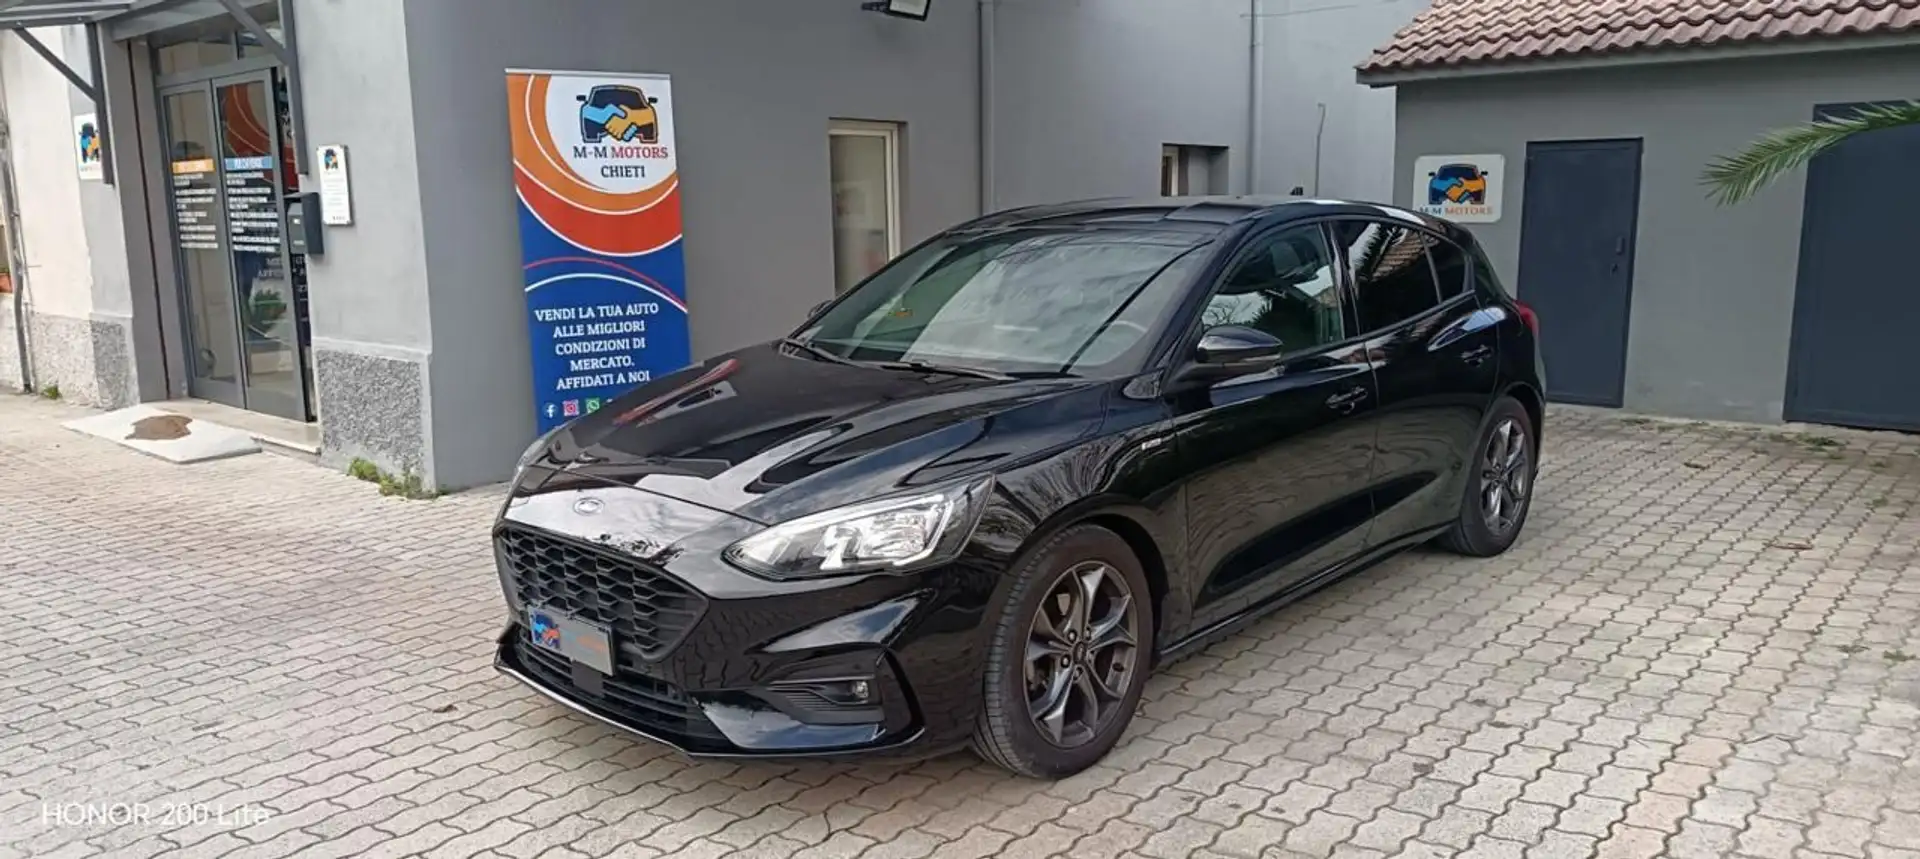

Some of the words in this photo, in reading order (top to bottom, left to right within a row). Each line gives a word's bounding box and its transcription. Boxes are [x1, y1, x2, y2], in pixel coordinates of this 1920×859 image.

[573, 145, 608, 159] M-M
[611, 146, 669, 159] MOTORS
[600, 165, 646, 178] CHIETI
[534, 308, 576, 322] VENDI
[578, 306, 596, 319] LA
[598, 305, 623, 318] TUA
[626, 302, 660, 315] AUTO
[553, 323, 585, 339] ALLE
[587, 320, 645, 336] MIGLIORI
[555, 338, 631, 356] CONDIZIONI
[633, 337, 646, 350] DI
[570, 355, 636, 372] MERCATO.
[556, 373, 614, 391] AFFIDATI
[616, 372, 626, 385] A
[628, 370, 651, 384] NOI
